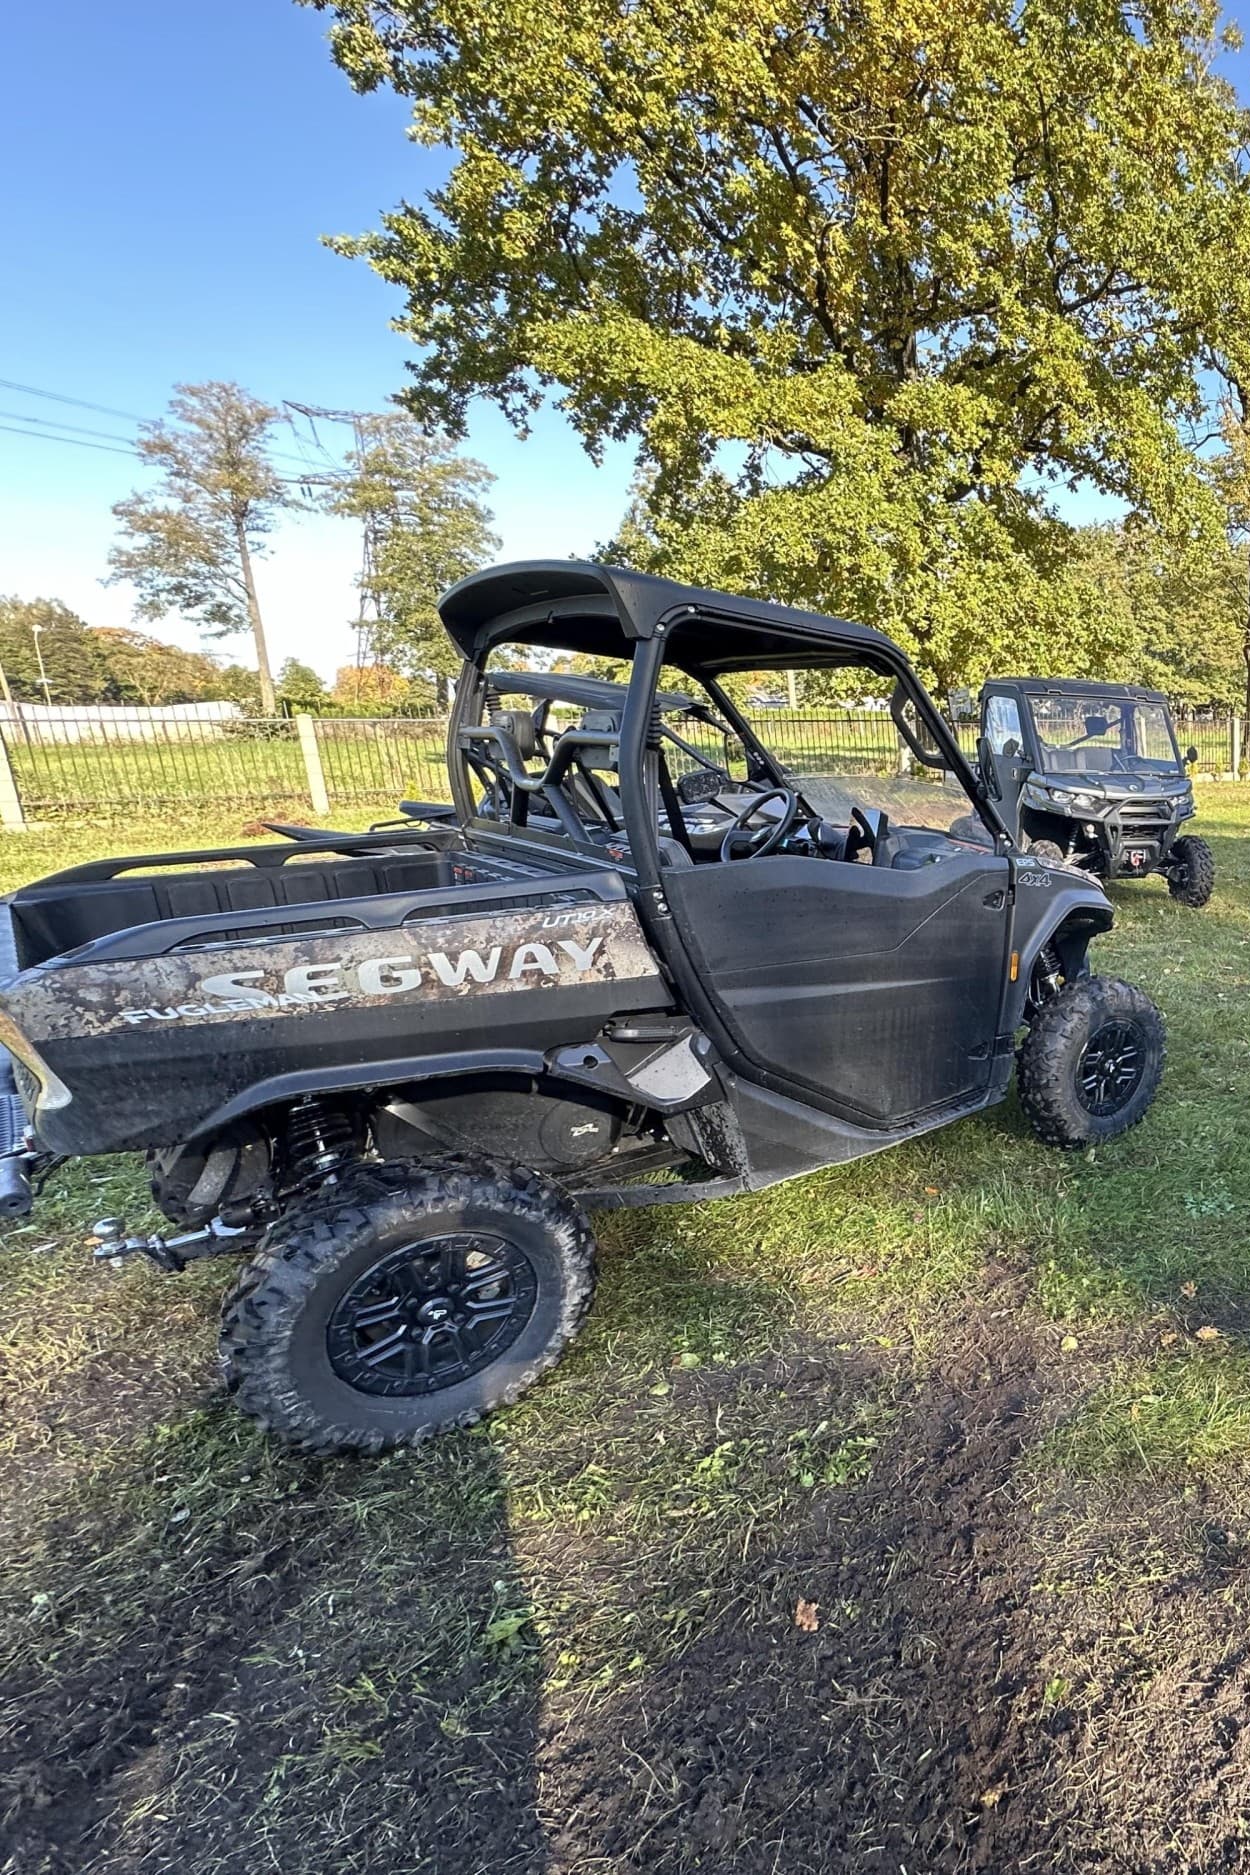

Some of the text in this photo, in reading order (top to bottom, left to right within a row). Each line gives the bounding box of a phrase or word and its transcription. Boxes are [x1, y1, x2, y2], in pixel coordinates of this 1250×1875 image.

[1018, 871, 1052, 887] 4x4
[201, 937, 604, 1004] SEGWAY
[119, 992, 322, 1024] FUGLEMAN
